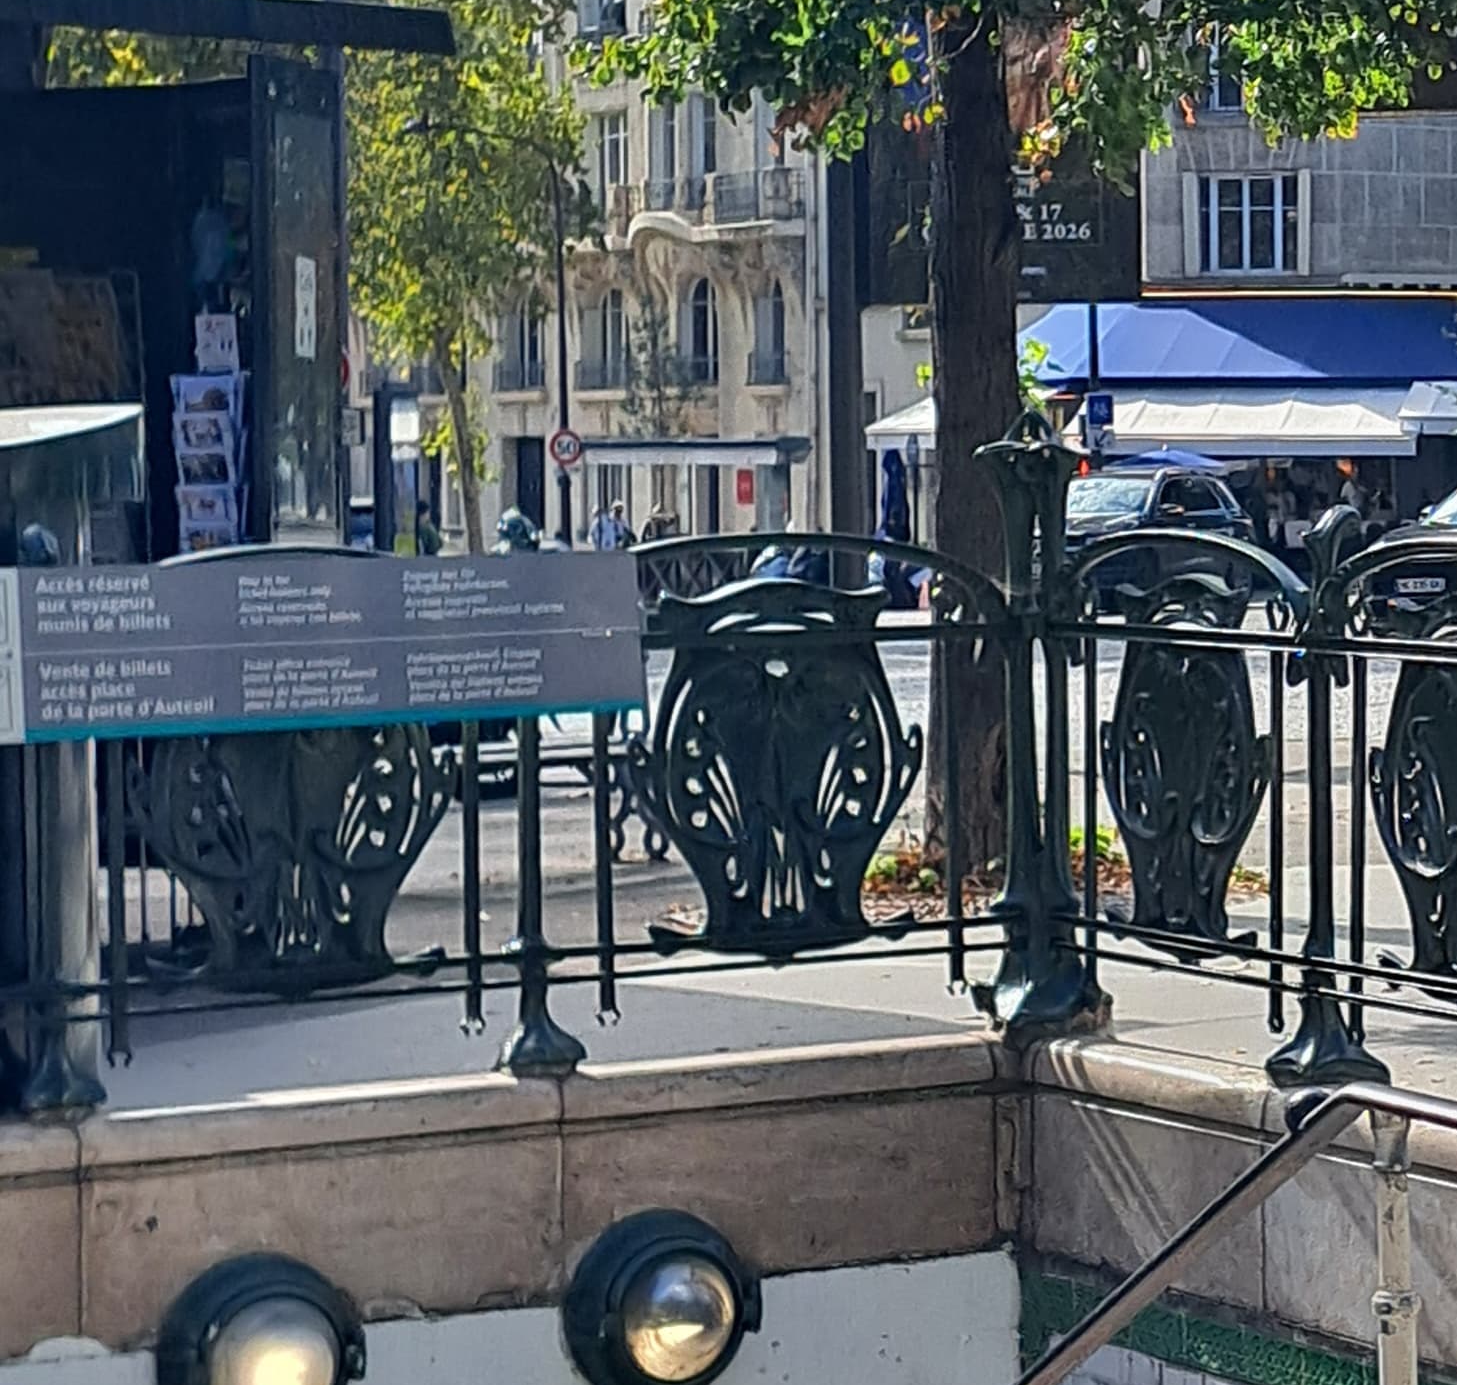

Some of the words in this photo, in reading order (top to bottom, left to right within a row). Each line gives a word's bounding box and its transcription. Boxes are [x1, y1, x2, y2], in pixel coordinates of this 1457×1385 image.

[1040, 203, 1063, 221] 17
[1023, 222, 1038, 240] E
[1041, 221, 1091, 240] 2026
[119, 613, 171, 631] billets
[38, 662, 90, 680] Vente
[94, 661, 115, 678] de
[120, 659, 172, 677] billets
[91, 681, 136, 702] place
[67, 702, 84, 718] la
[88, 701, 133, 722] porte
